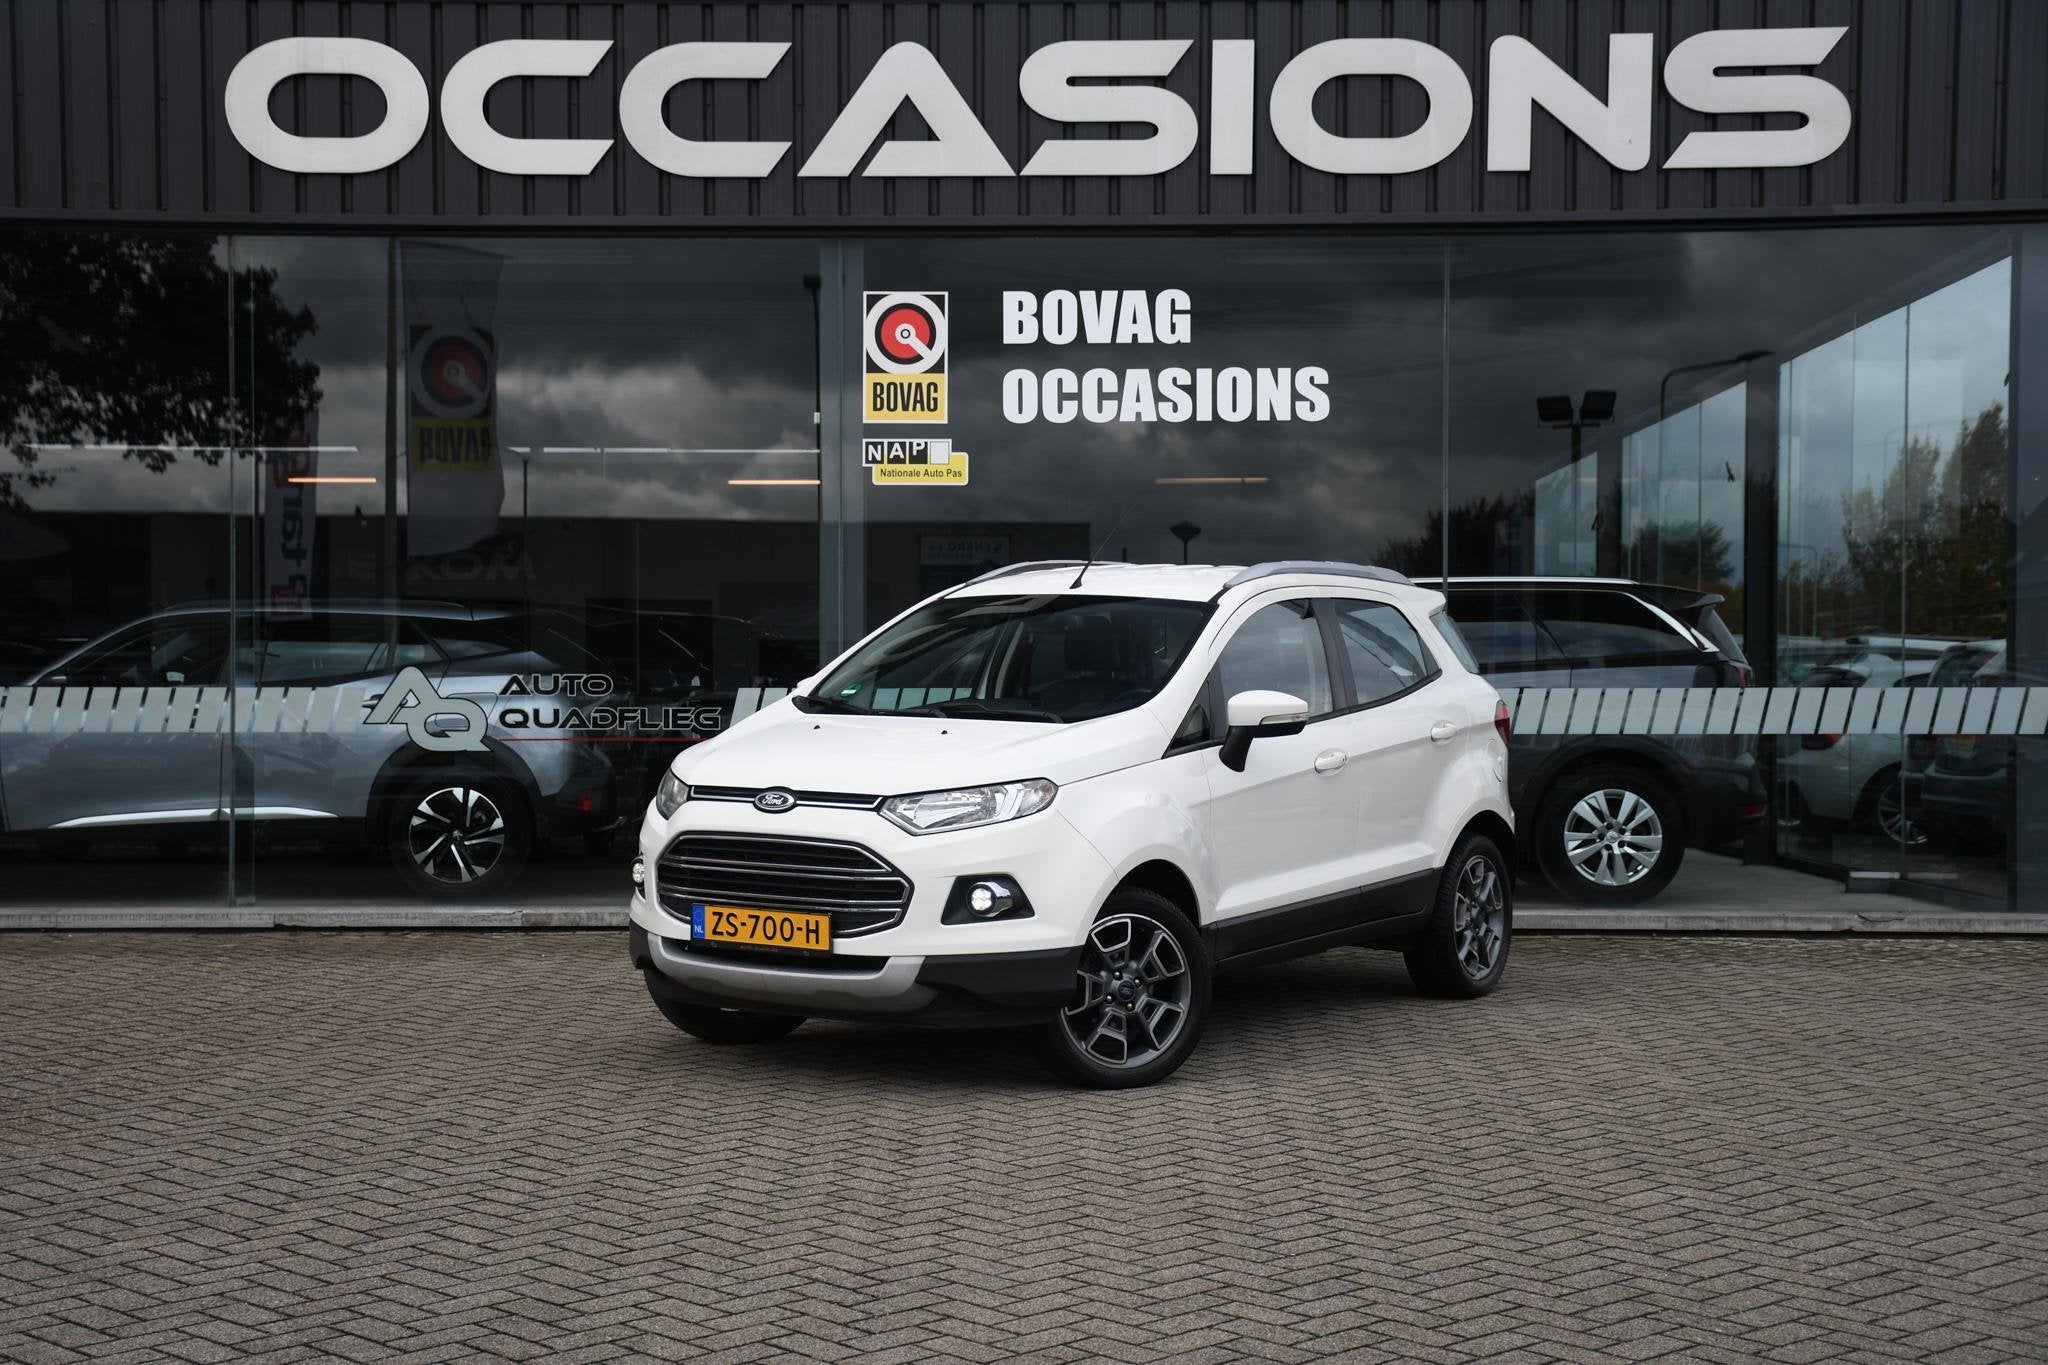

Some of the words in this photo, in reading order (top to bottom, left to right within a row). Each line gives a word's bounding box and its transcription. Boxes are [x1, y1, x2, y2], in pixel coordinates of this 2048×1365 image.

[224, 25, 1852, 177] OCCASIONS
[1002, 288, 1192, 345] BOVAG
[872, 381, 939, 412] BOVAG
[1002, 366, 1331, 424] OCCASIONS
[868, 440, 926, 461] NAP
[880, 468, 921, 478] Nationale
[923, 468, 944, 478] Auto
[946, 468, 962, 478] Pas
[499, 673, 614, 697] AUTO
[499, 707, 722, 731] QUADFLIEG
[762, 794, 785, 805] Ford
[694, 925, 705, 934] NL
[711, 911, 820, 945] ZS-700-H
